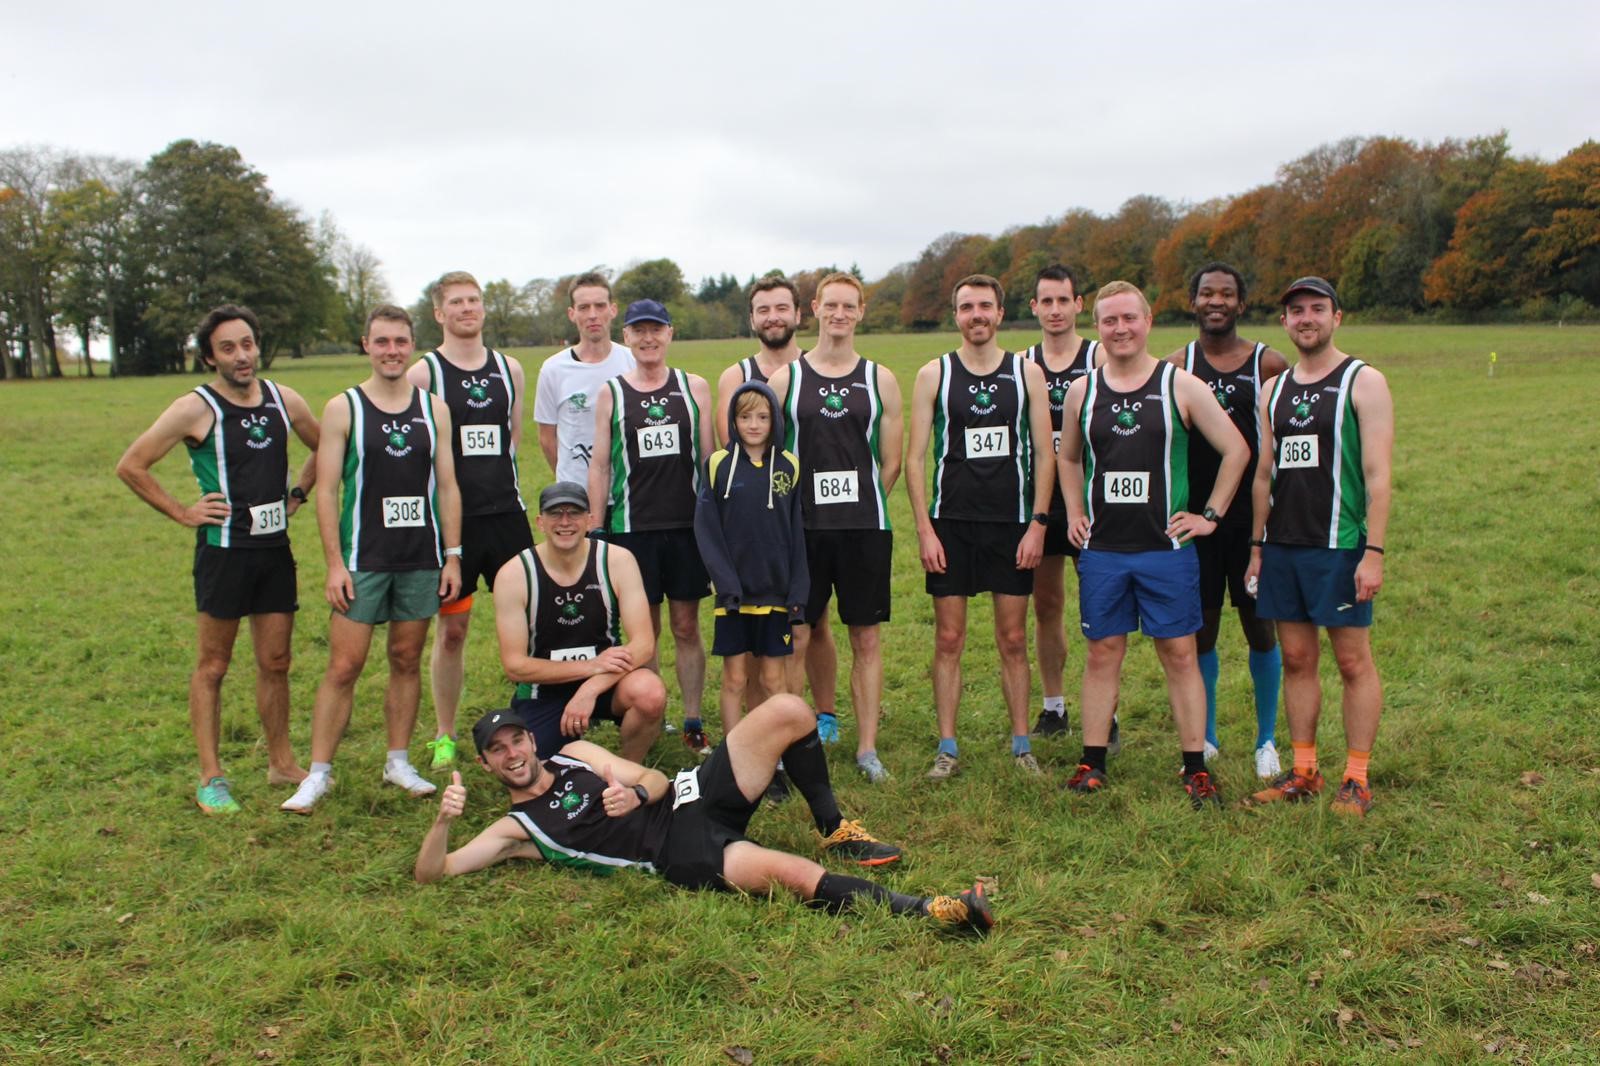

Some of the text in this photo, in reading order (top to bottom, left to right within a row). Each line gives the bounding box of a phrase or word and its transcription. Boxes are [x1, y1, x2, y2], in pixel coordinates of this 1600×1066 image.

[462, 376, 488, 389] CLC
[968, 381, 998, 394] CLC
[819, 384, 850, 397] CLC
[1291, 390, 1320, 405] CLC
[640, 396, 669, 409] CLC
[970, 404, 997, 415] Striders
[1111, 399, 1142, 413] CLC
[820, 407, 849, 418] Striders
[241, 413, 268, 428] CLC
[381, 420, 411, 433] CLC
[1111, 424, 1141, 436] Striders
[467, 431, 495, 449] 554
[643, 430, 674, 451] 643
[972, 432, 1003, 453] 347
[385, 445, 412, 457] Striders
[1284, 441, 1311, 462] 368
[820, 478, 852, 498] 684
[1110, 477, 1143, 497] 480
[260, 508, 281, 529] 313
[390, 502, 419, 522] 308
[554, 592, 584, 605] CLC
[549, 781, 574, 809] CLC
